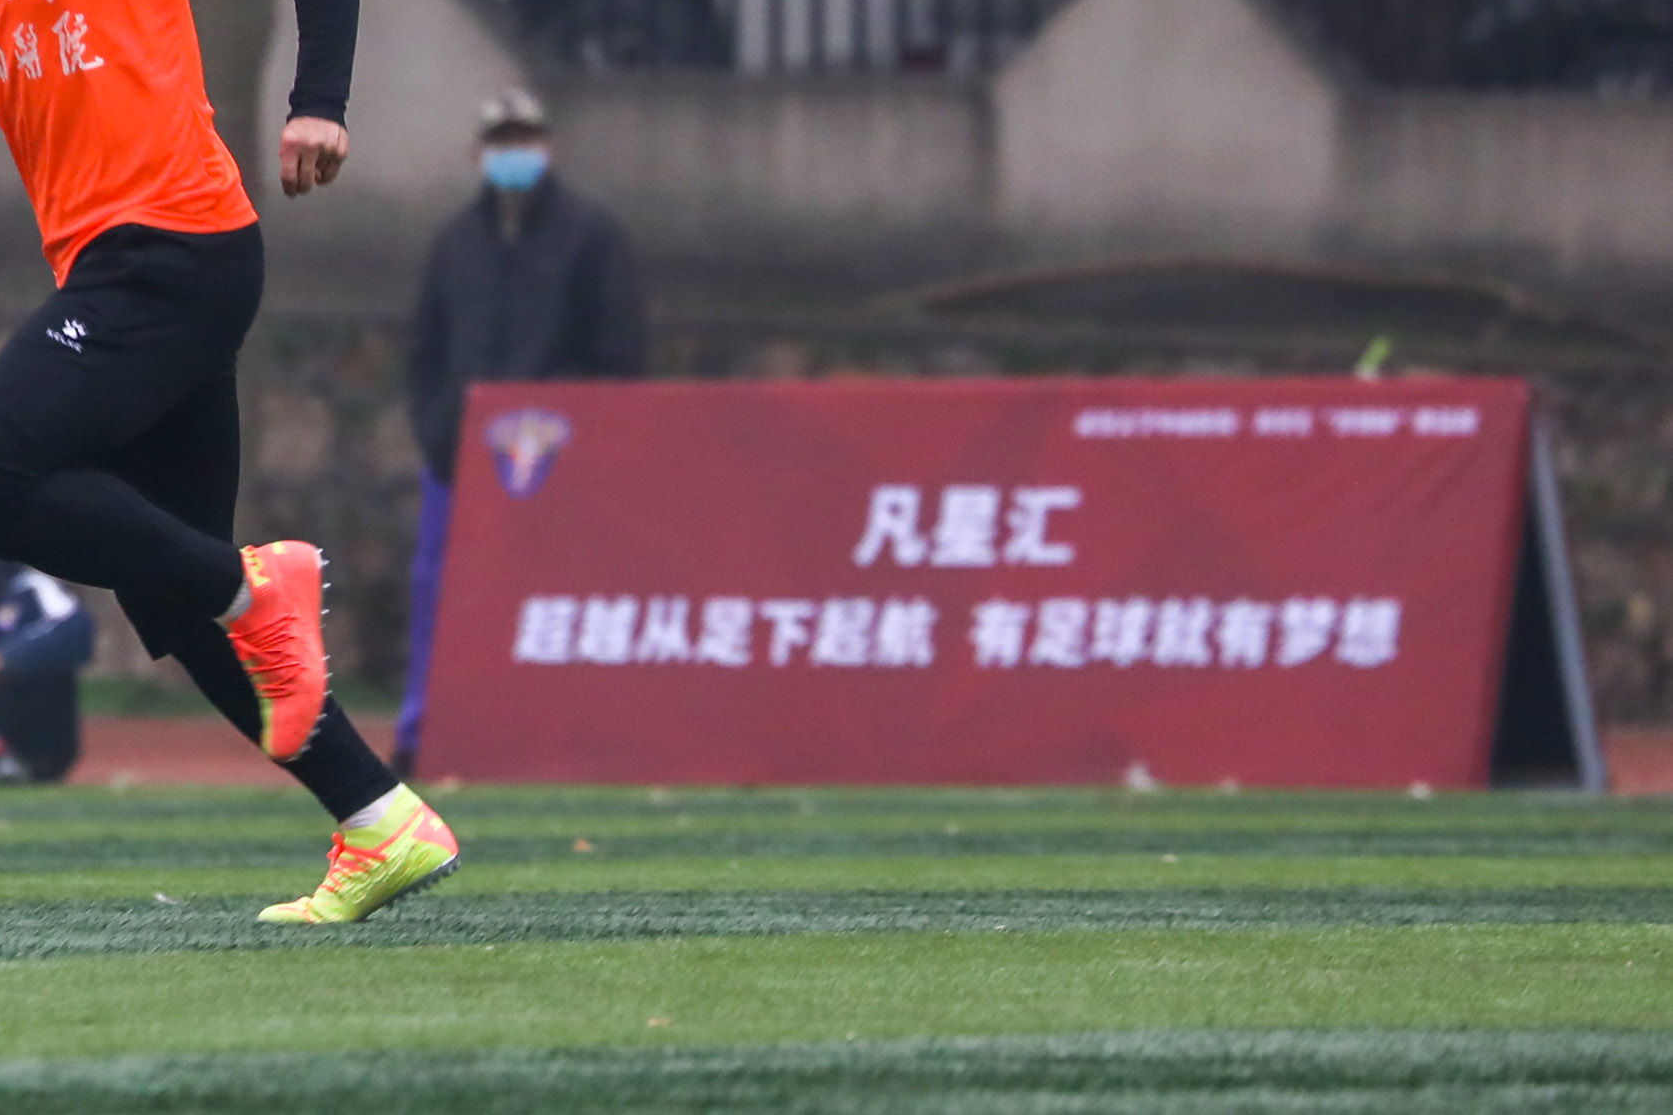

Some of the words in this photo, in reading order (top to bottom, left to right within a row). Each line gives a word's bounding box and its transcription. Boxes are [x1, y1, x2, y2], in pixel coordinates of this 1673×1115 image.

[853, 484, 1083, 569] 凡星汇
[513, 595, 939, 668] 超越从足下起航
[969, 596, 1402, 668] 有足球就有梦想
